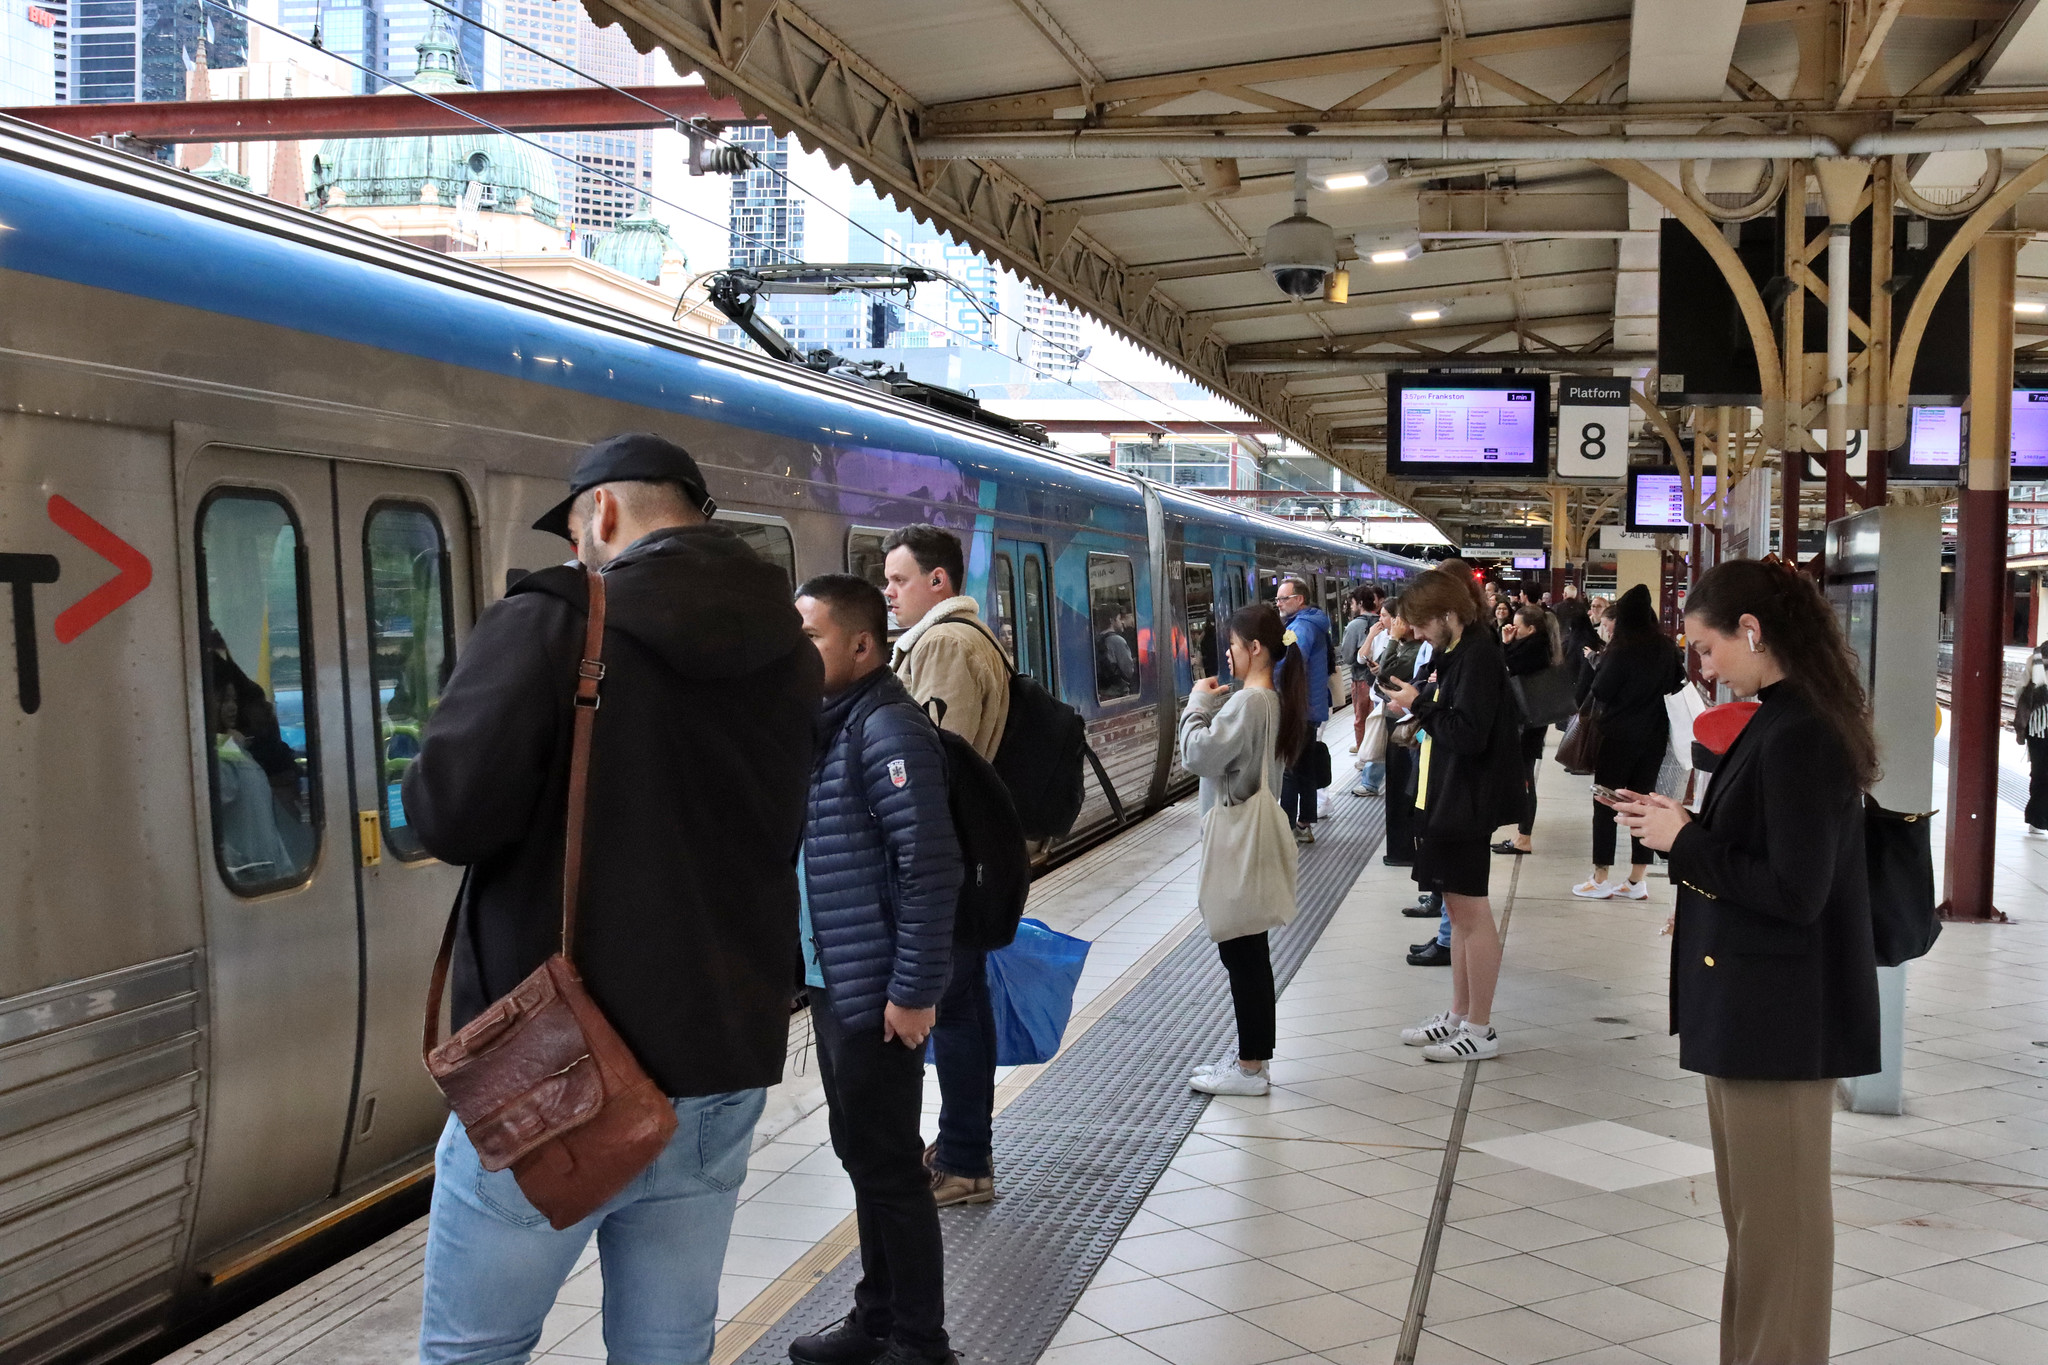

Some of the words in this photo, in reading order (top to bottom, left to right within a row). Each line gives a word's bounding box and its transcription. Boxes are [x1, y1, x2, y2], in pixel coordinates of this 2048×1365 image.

[28, 5, 56, 28] BHP
[1428, 392, 1465, 400] Frankston
[1569, 387, 1621, 399] Platform
[1580, 422, 1606, 460] 8
